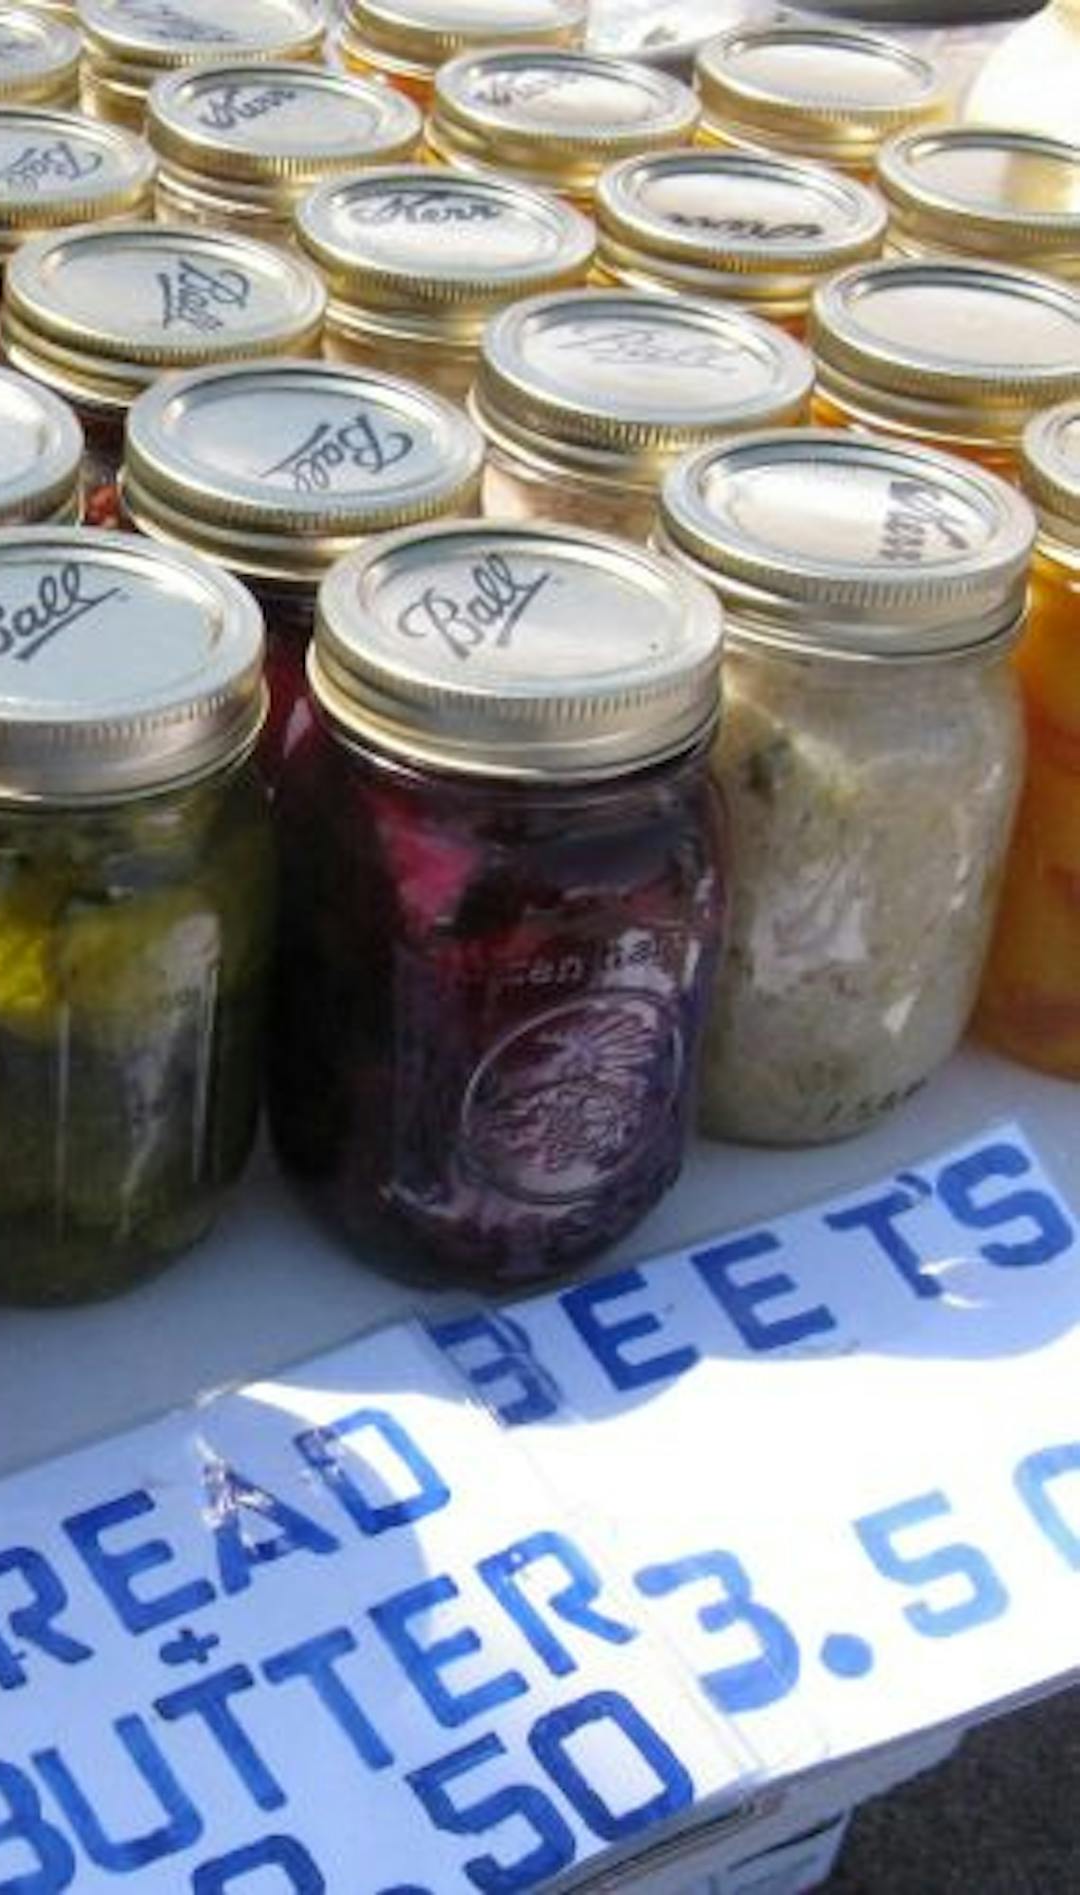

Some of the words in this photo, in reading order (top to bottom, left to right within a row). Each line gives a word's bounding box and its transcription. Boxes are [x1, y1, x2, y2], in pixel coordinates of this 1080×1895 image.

[346, 190, 504, 226] Kerr
[258, 414, 415, 493] Ball
[396, 554, 562, 660] Ball
